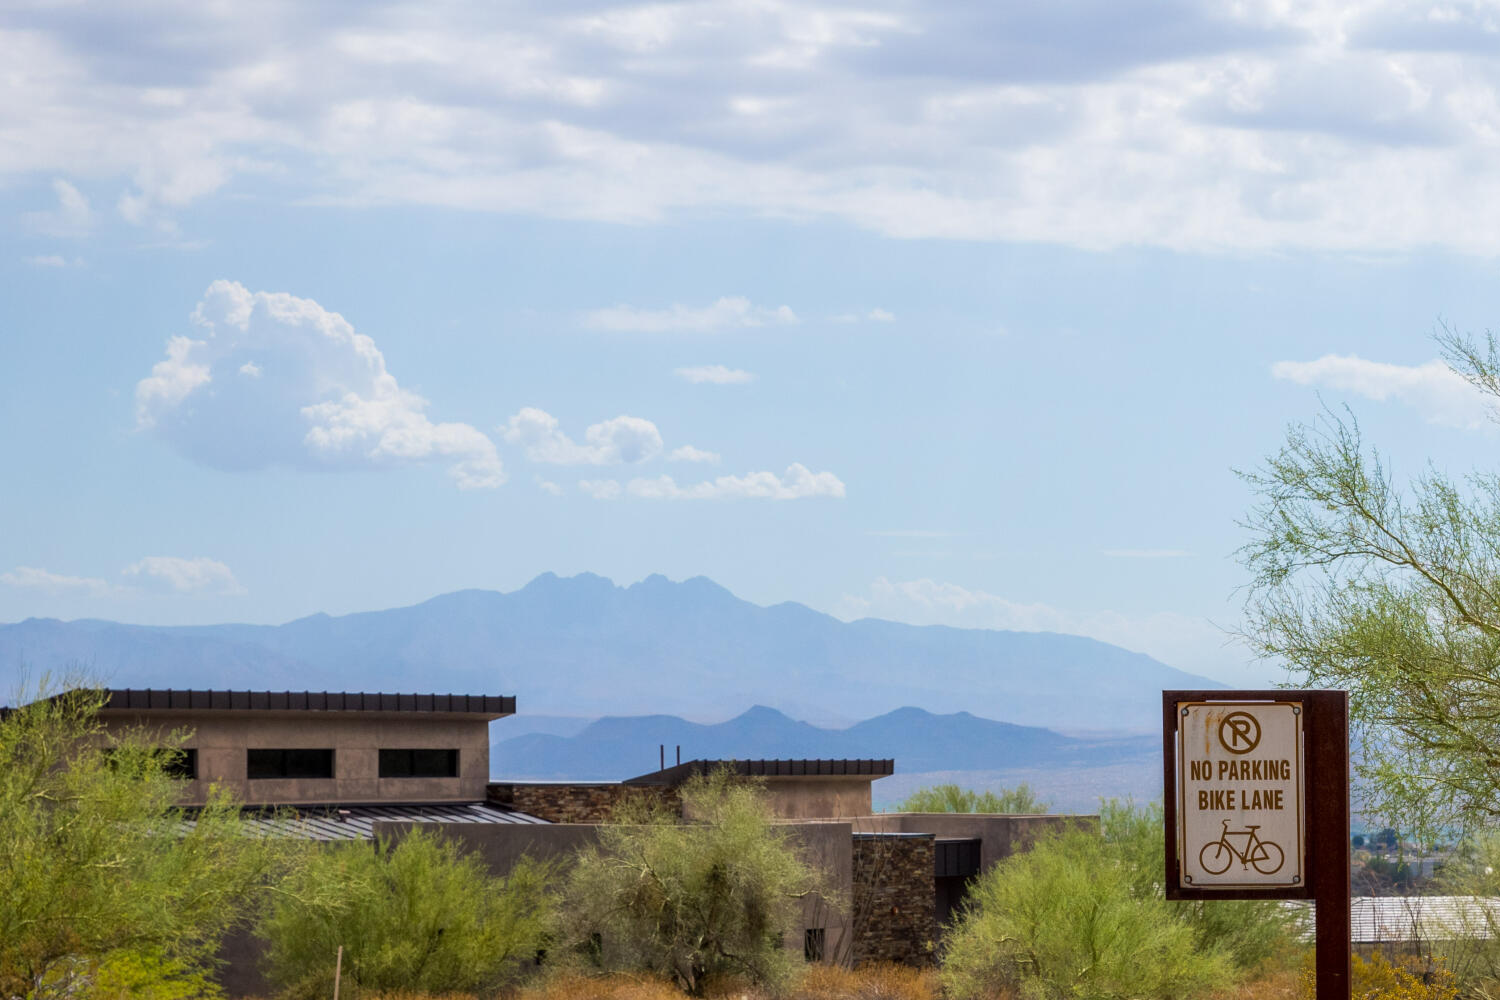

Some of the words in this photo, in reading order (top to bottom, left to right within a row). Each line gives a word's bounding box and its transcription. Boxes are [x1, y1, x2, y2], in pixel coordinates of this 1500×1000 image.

[1190, 760, 1213, 781] NO
[1218, 760, 1291, 781] PARKING
[1198, 790, 1236, 811] BIKE
[1241, 790, 1284, 811] LANE
